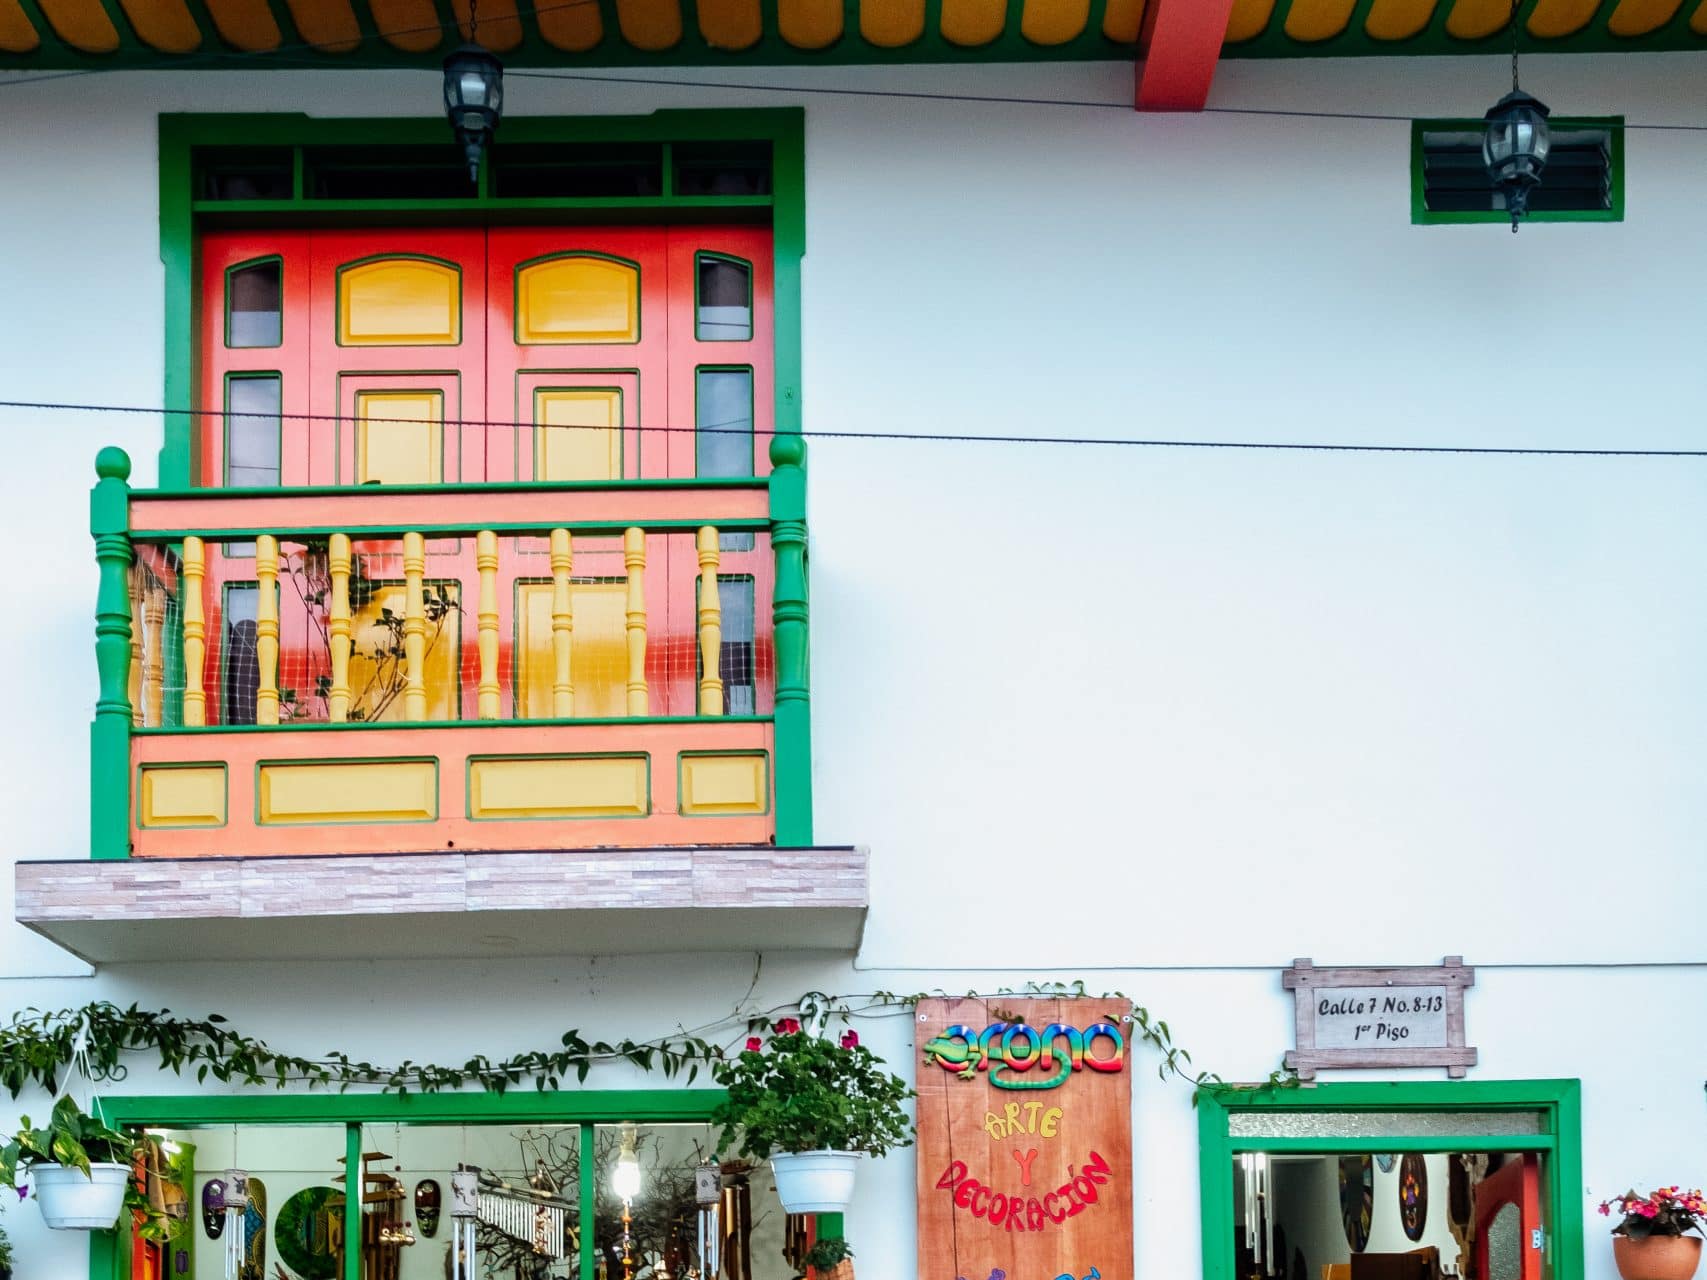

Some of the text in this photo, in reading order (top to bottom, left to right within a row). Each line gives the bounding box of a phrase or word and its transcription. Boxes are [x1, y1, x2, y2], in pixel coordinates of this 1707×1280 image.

[1318, 998, 1364, 1016] Calle
[1369, 998, 1377, 1013] 7
[1376, 1022, 1409, 1041] Piso
[984, 1101, 1064, 1141] ARTE
[1013, 1149, 1038, 1186] Y
[936, 1151, 1112, 1232] DECORACIÓN
